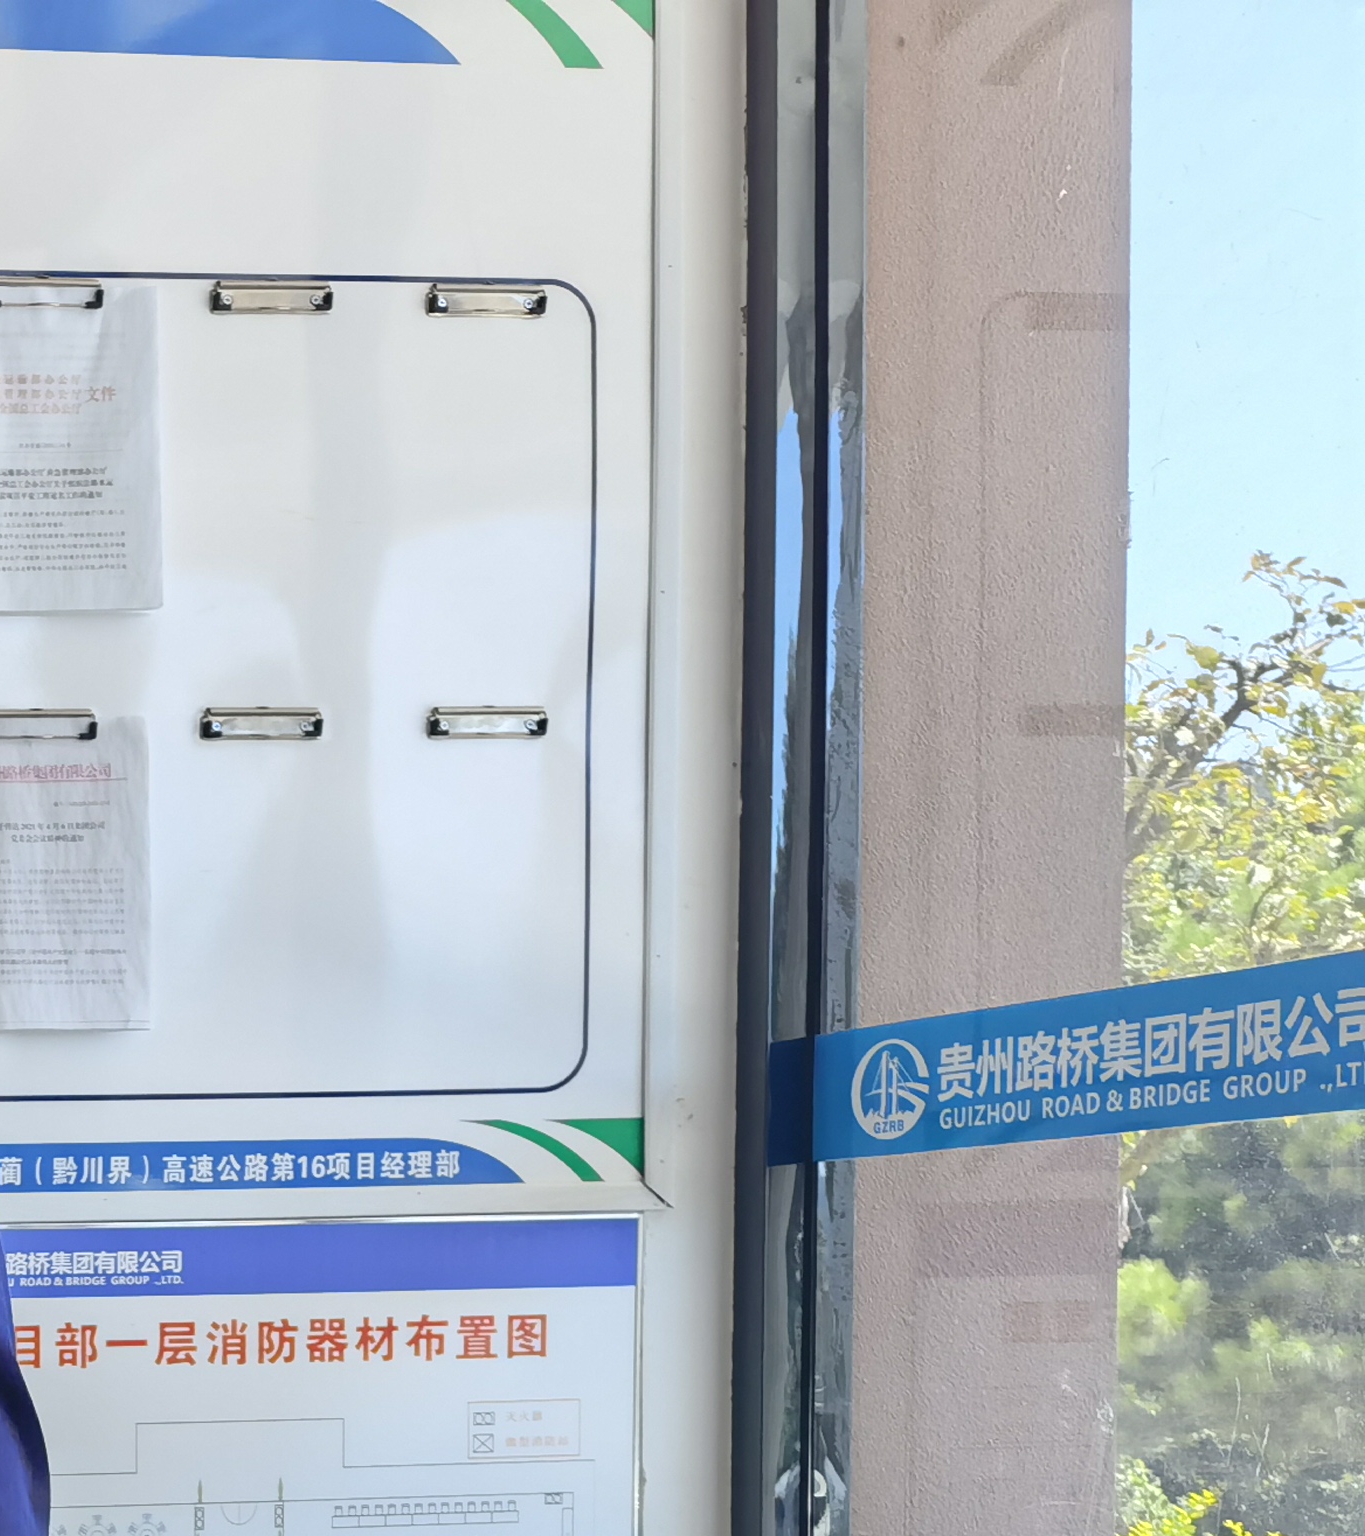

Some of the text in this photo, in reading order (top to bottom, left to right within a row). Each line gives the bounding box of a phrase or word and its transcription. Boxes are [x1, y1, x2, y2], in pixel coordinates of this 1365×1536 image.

[85, 386, 117, 403] 文件
[936, 986, 1365, 1102] 贵州路桥集团有限公司
[938, 1098, 1031, 1131] GUIZHOU
[1041, 1092, 1101, 1120] ROAD
[1106, 1092, 1124, 1113] &
[1129, 1081, 1211, 1109] BRIDGE
[1223, 1068, 1307, 1100] GROUP
[872, 1118, 905, 1135] GZRB
[20, 1276, 52, 1287] ROAD
[53, 1276, 63, 1287] &
[66, 1276, 107, 1287] BRIDGE
[110, 1275, 150, 1287] GROUP
